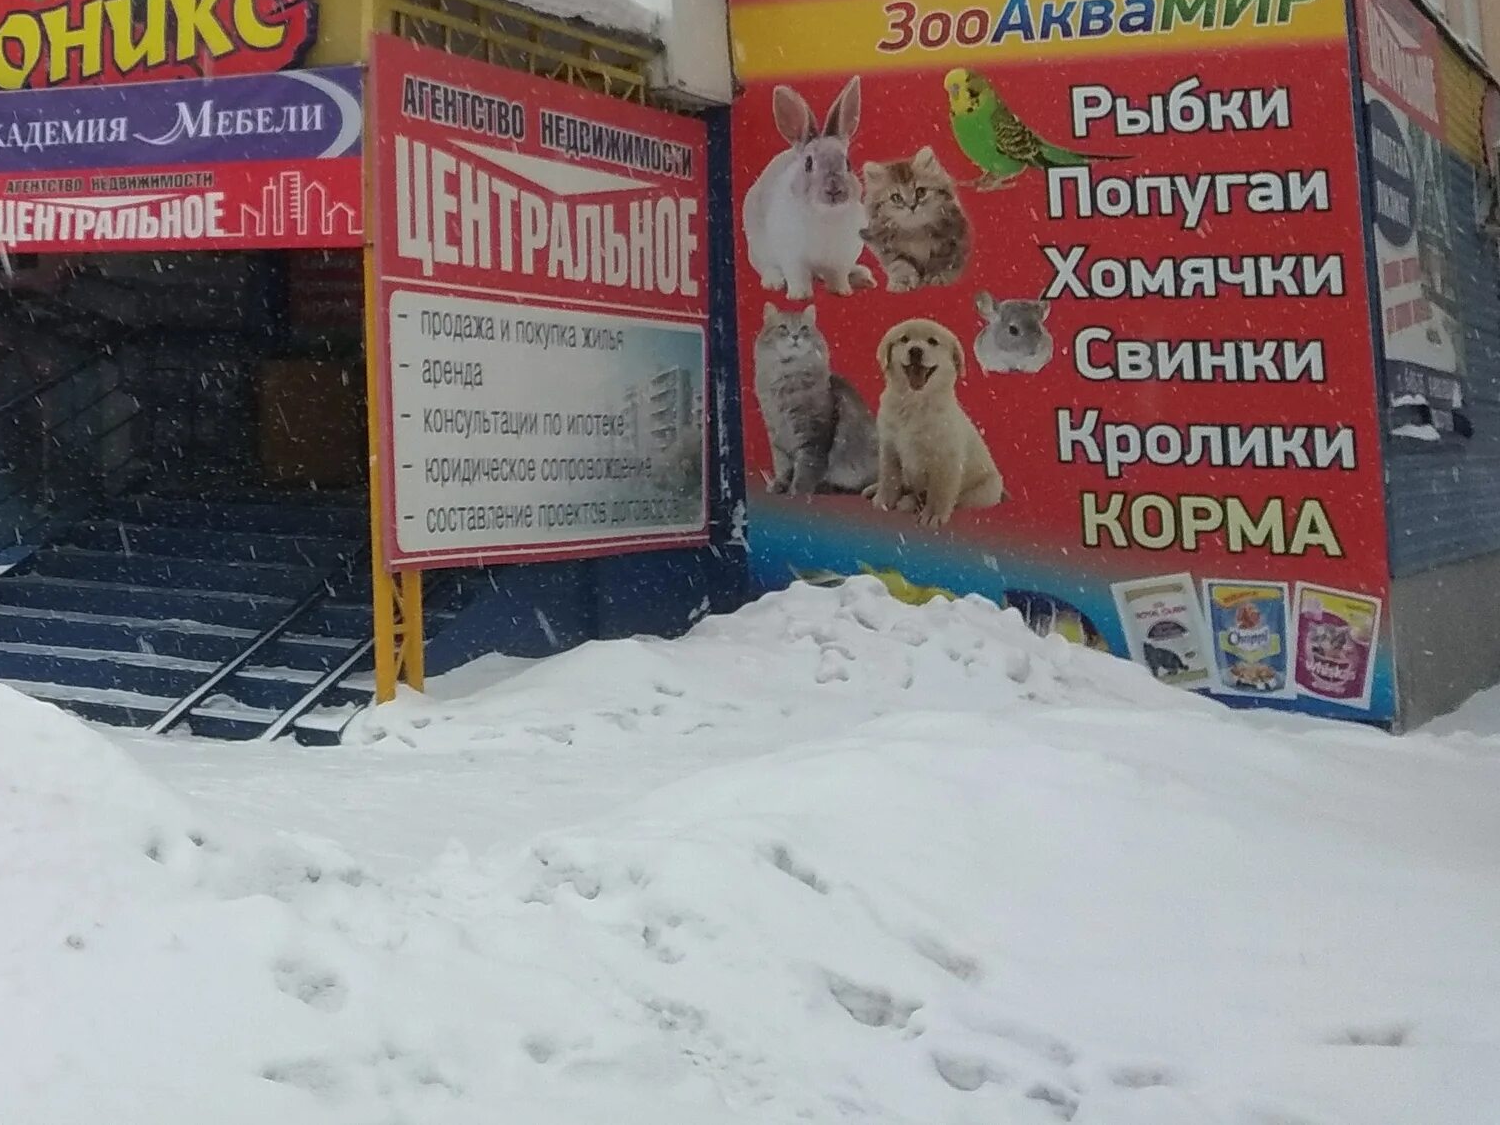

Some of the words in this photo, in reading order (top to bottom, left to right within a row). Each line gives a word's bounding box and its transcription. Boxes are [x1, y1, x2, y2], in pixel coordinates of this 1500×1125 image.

[403, 76, 525, 141] АГЕНТСТВО
[539, 108, 692, 179] НЕДВИЖИМОСТИ
[1070, 77, 1292, 139] Рыбки
[4, 177, 83, 194] АГЕНТСТВО
[90, 172, 214, 192] НЕДВИЖИМОСТИ
[1046, 164, 1330, 229] Попугаи
[395, 135, 698, 297] ЦЕНТРАЛЬНОЕ
[1042, 245, 1346, 300] Хомячки
[420, 309, 495, 341] продажа
[501, 322, 510, 339] и
[515, 319, 577, 350] покупка
[581, 328, 624, 350] жилья
[1073, 326, 1326, 382] Свинки
[421, 357, 483, 388] аренда
[423, 408, 537, 440] консультации
[543, 414, 561, 435] по
[566, 414, 624, 436] ипотеке
[1055, 408, 1357, 478] Кролики
[425, 457, 536, 486] юридическое
[426, 504, 532, 534] составление
[538, 502, 607, 528] проектов
[1080, 492, 1343, 556] КОРМА
